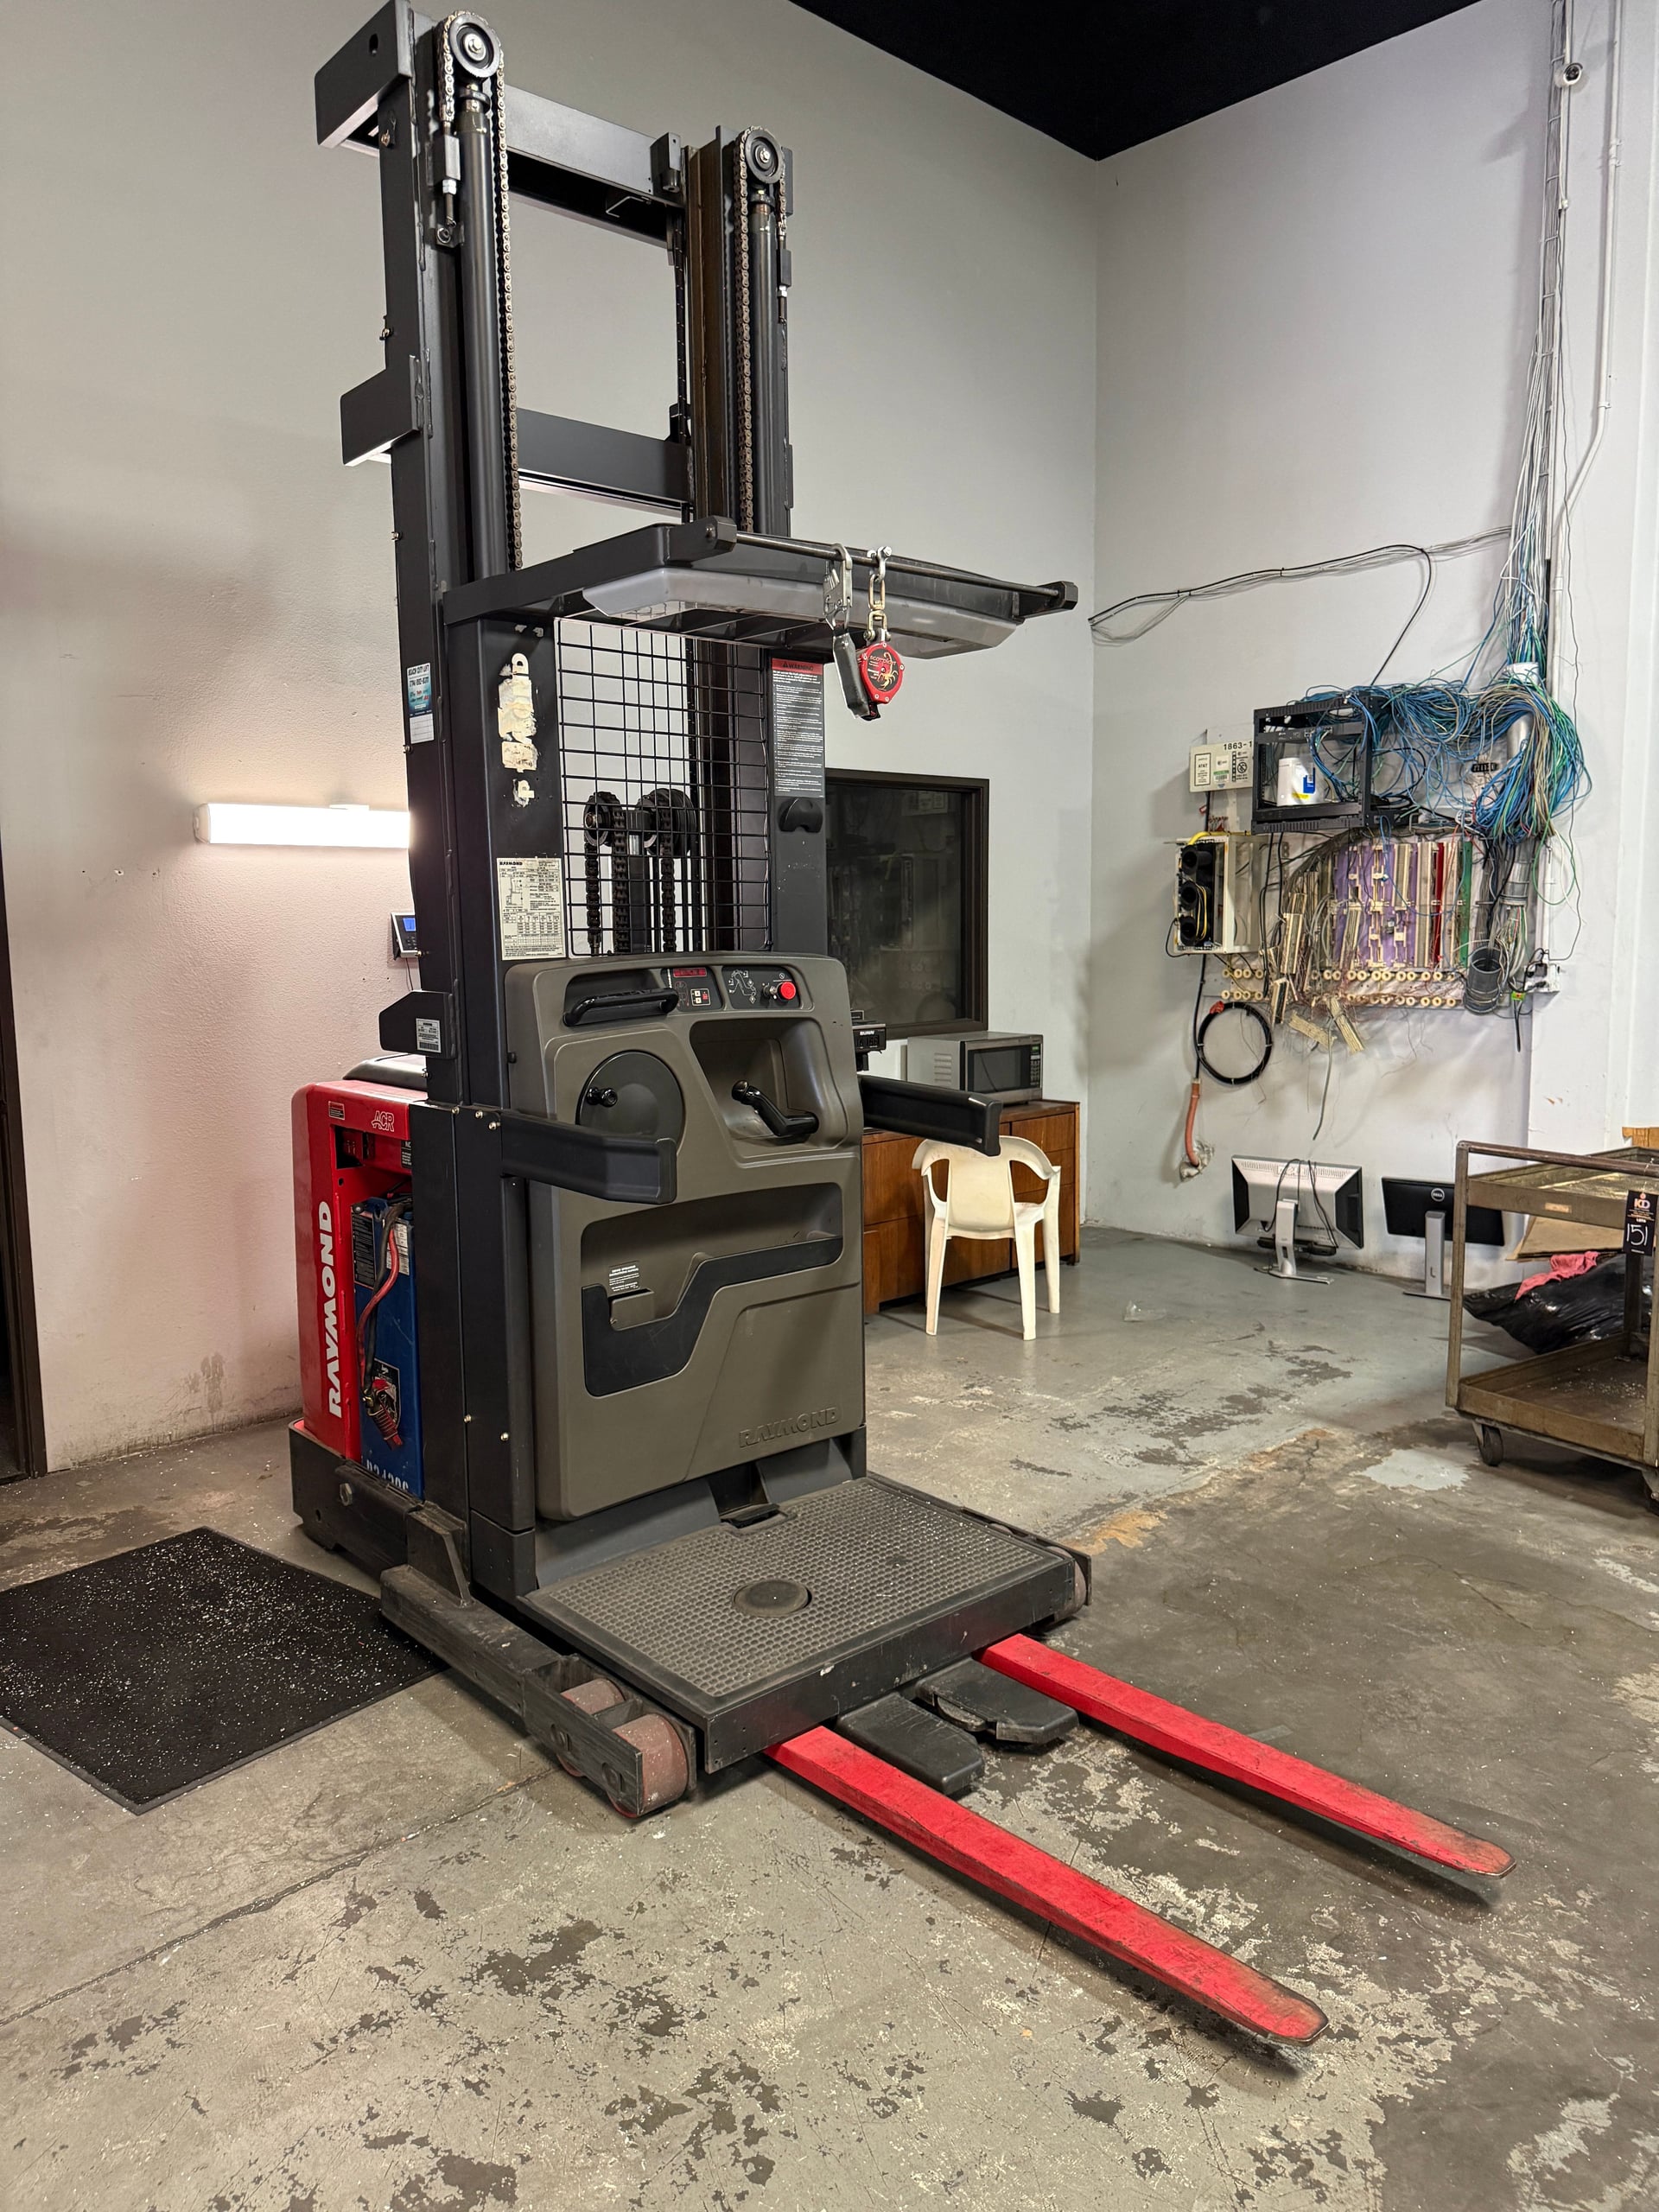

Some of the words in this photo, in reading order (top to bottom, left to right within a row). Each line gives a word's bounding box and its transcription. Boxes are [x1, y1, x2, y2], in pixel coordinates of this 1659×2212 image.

[1224, 741, 1252, 750] 1863-1
[372, 1110, 394, 1132] ACR
[1626, 1223, 1648, 1246] 151
[318, 1201, 342, 1418] RAYMOND
[739, 1407, 838, 1448] RAYMOND
